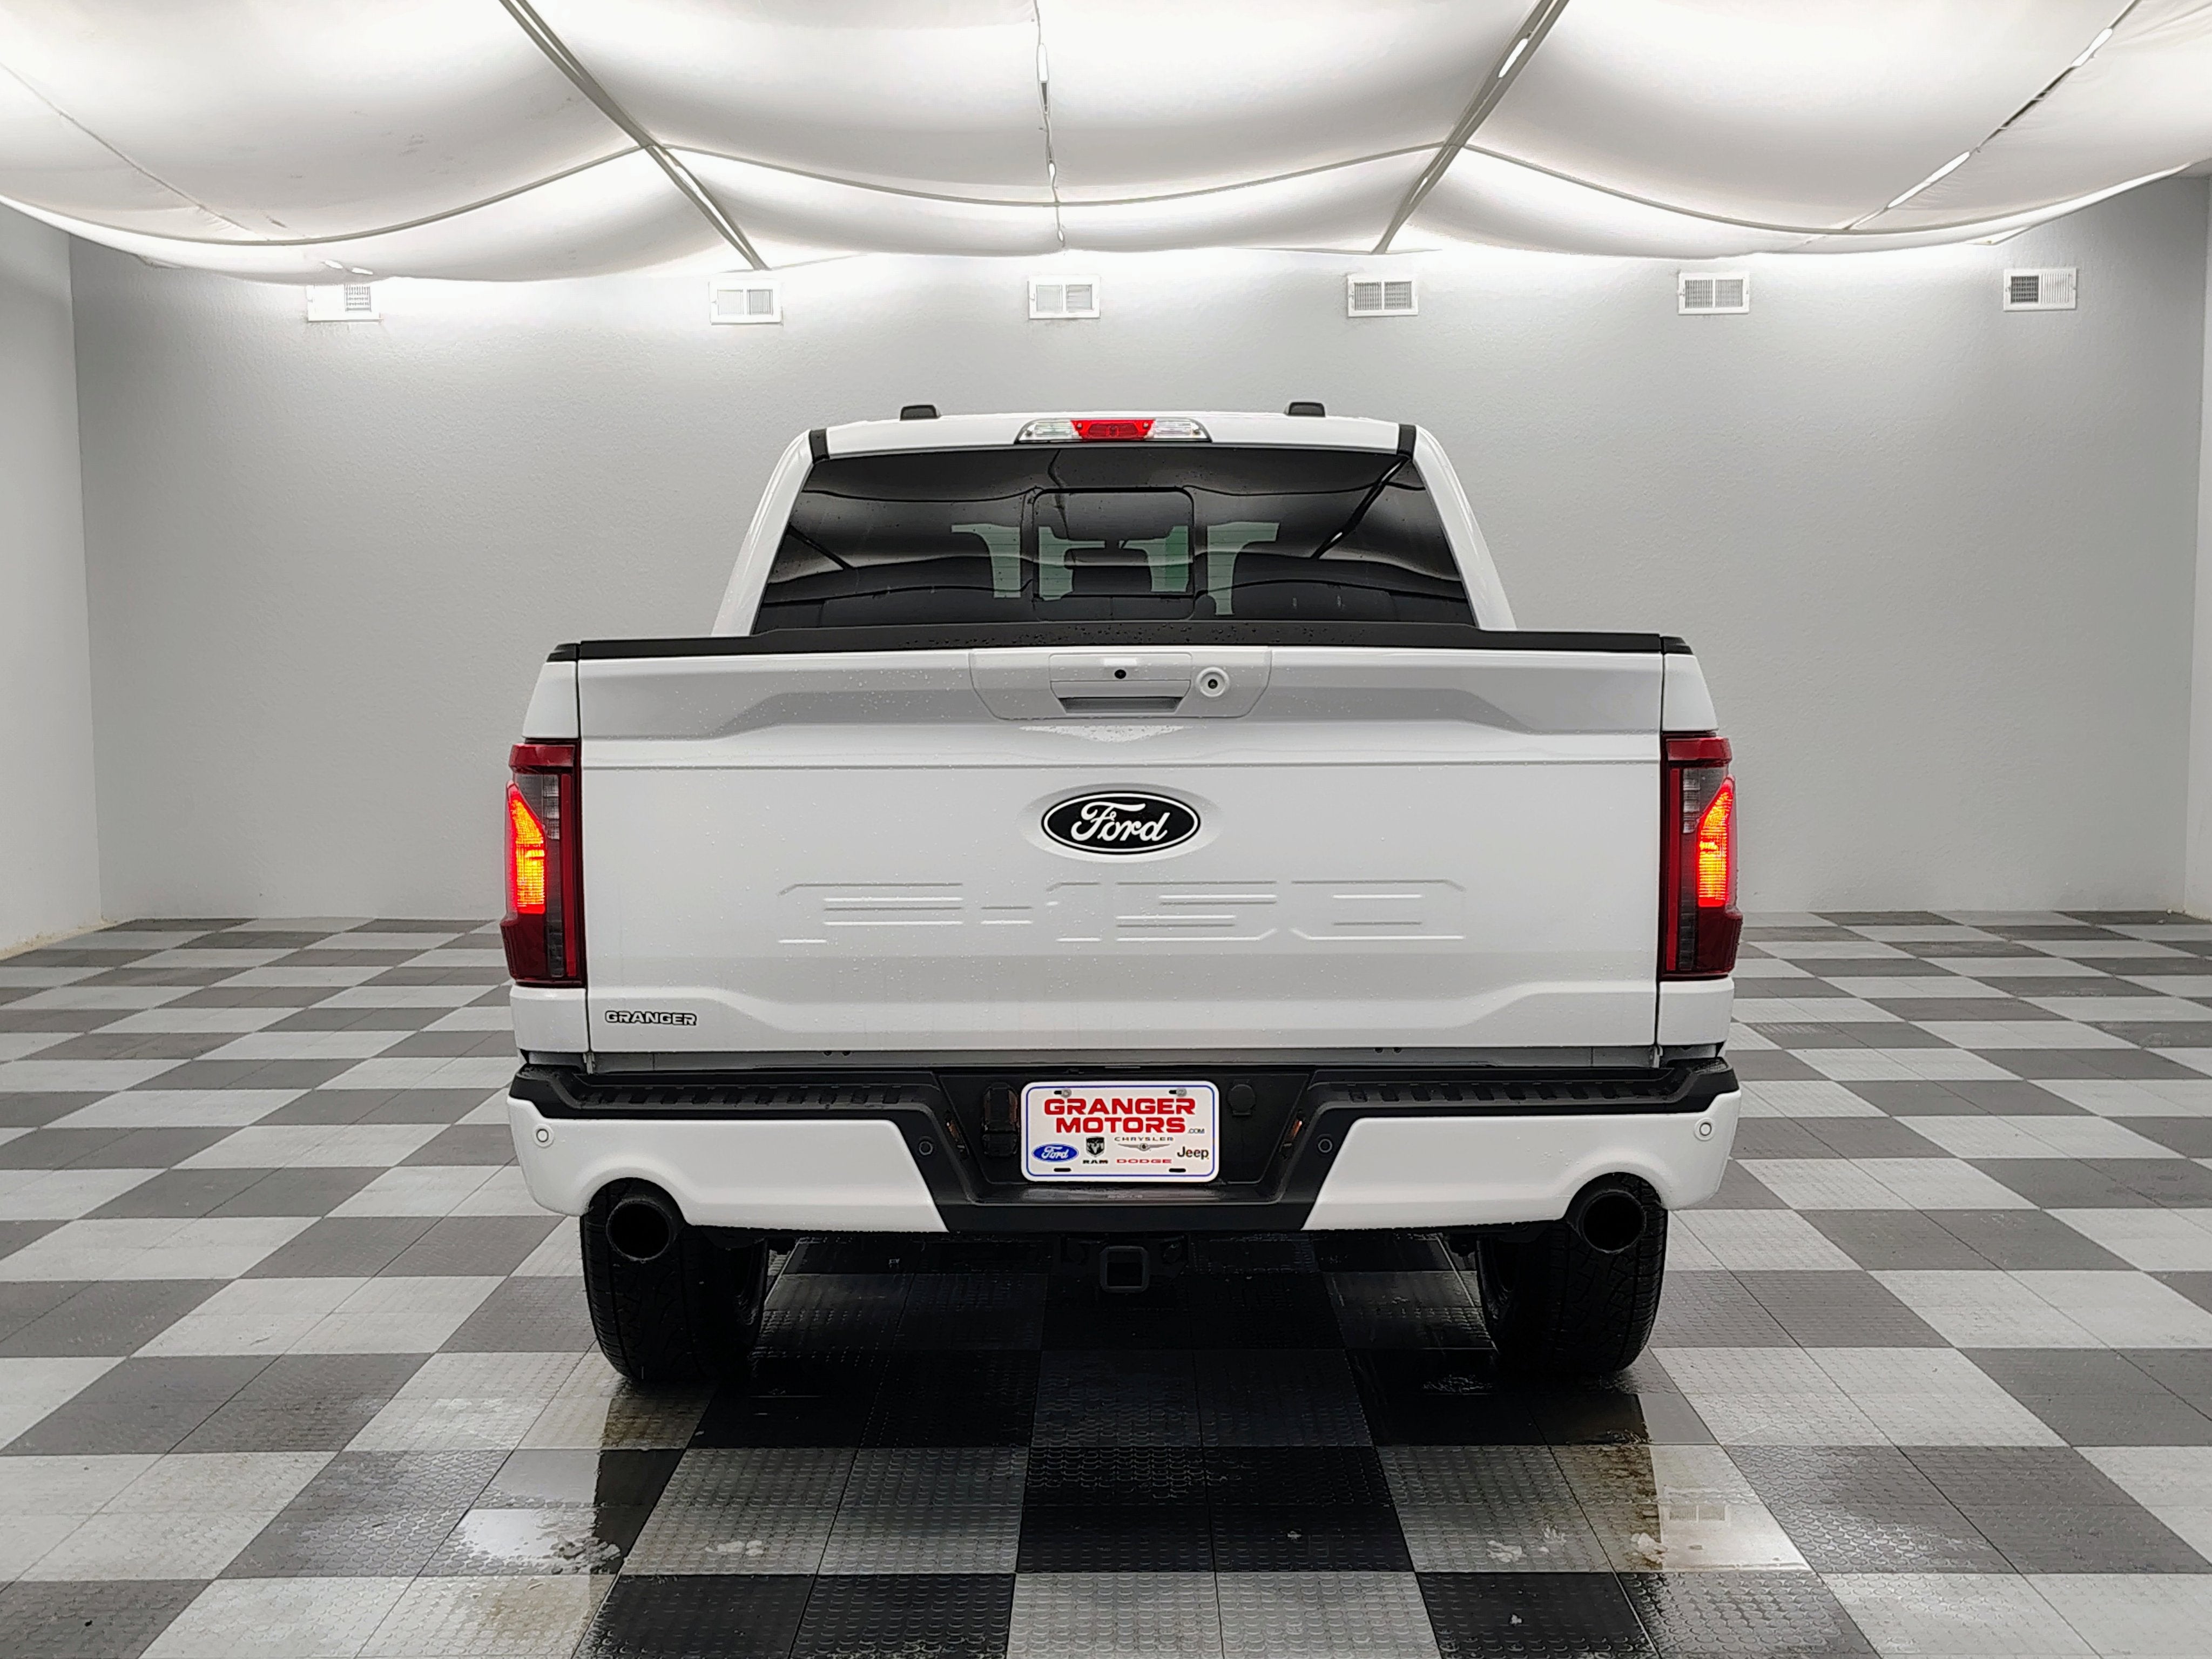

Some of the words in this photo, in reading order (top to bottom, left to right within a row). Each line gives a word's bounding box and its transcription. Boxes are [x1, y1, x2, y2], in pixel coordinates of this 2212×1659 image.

[1071, 801, 1170, 841] Ford
[605, 1010, 697, 1026] GRANGER
[1044, 1098, 1195, 1115] GRANGER
[1056, 1117, 1185, 1133] MOTORS
[1041, 1147, 1069, 1159] Ford
[1177, 1146, 1209, 1159] Jeep
